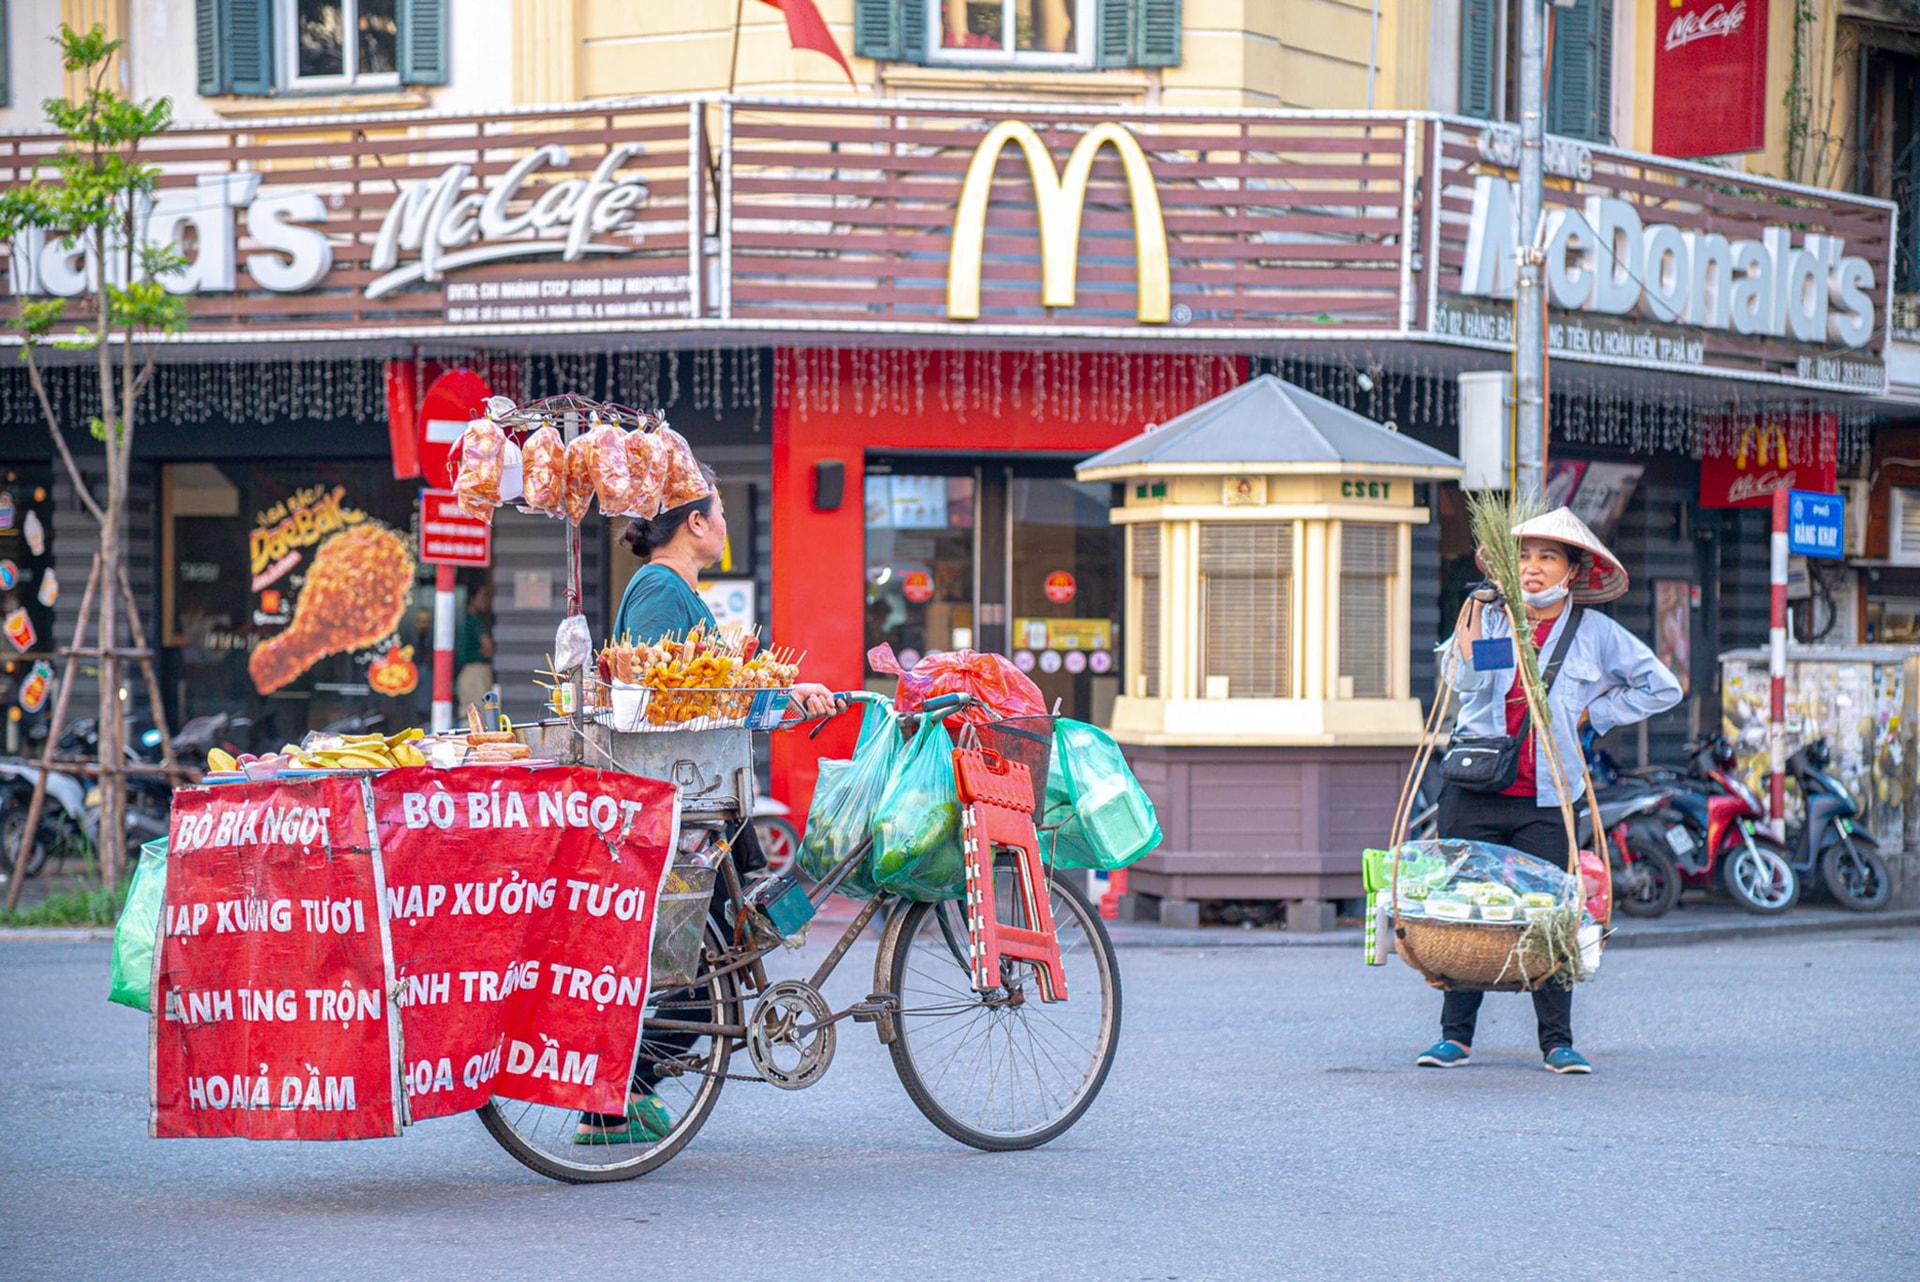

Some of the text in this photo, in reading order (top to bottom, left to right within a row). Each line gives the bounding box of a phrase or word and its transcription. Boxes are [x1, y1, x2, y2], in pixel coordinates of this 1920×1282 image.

[1460, 174, 1877, 350] McDonald's
[1341, 479, 1393, 500] CSGT
[175, 800, 332, 856] BÒ BÍA NGỌT
[402, 780, 456, 829] BÒ
[467, 780, 529, 829] BÍA
[300, 896, 366, 934] TƯƠI
[387, 870, 646, 926] NẠP XƯỞNG TƯƠI
[305, 979, 382, 1030] TRỘN
[550, 965, 643, 1012] TRỘN
[505, 1032, 600, 1087] DẦM
[280, 1062, 357, 1112] DẦM
